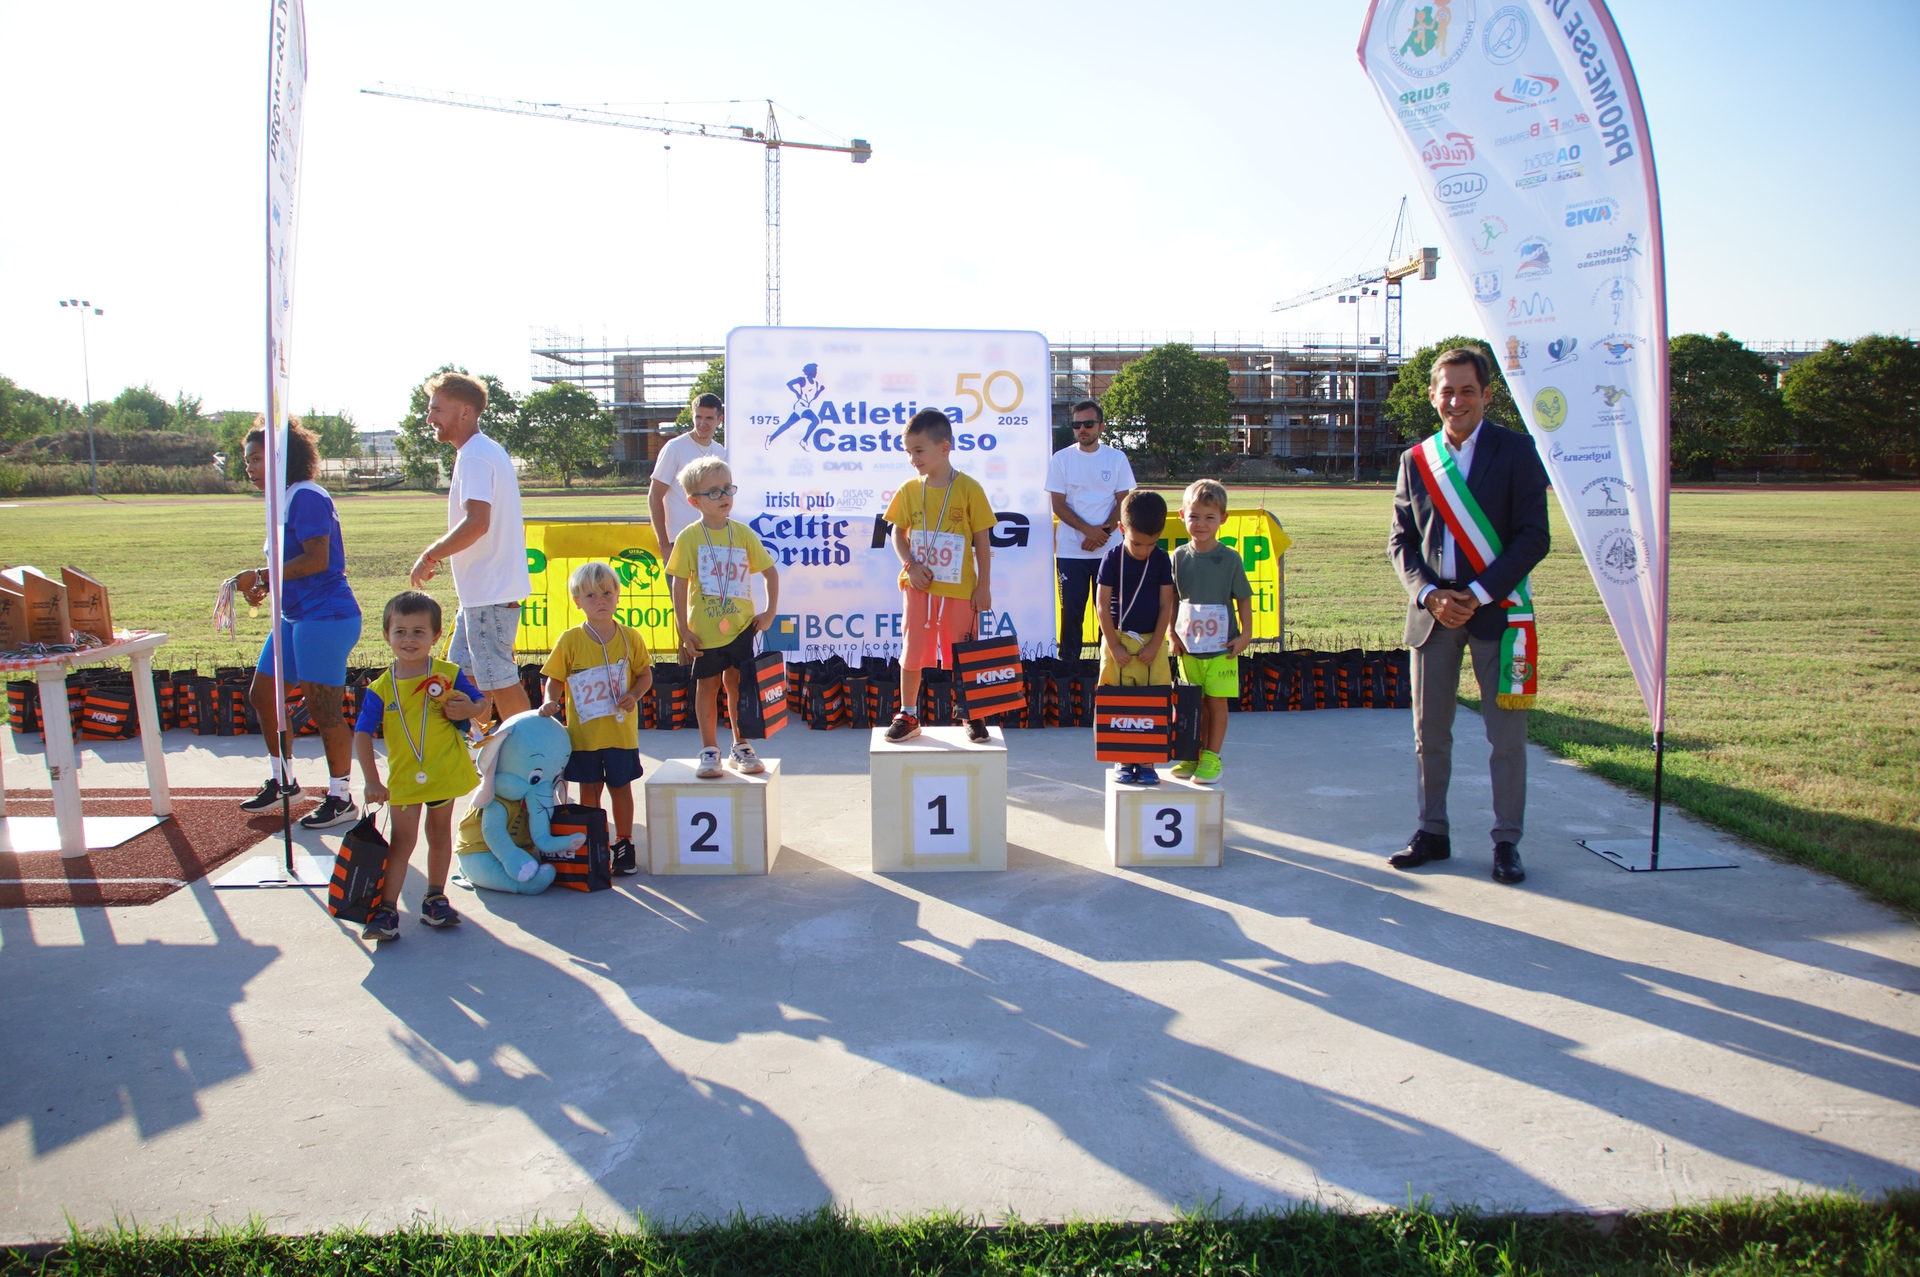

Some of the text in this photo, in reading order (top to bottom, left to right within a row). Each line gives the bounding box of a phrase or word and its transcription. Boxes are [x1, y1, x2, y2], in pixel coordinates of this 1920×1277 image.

[955, 370, 1024, 423] 50
[749, 415, 780, 425] 1975
[818, 400, 964, 425] Atletia
[997, 416, 1029, 425] 2025
[813, 427, 998, 452] Casteso
[766, 491, 835, 511] irish pub
[749, 512, 849, 540] Celtic
[871, 511, 1030, 549] KG
[917, 545, 953, 567] 539
[710, 561, 749, 583] 497
[614, 606, 675, 628] spor
[806, 611, 1018, 639] BCC FEEA
[806, 643, 903, 651] CREDITO COOP
[976, 667, 1016, 685] KING
[1218, 669, 1237, 679] WIN
[581, 679, 621, 705] 228
[764, 685, 783, 703] KING
[92, 711, 118, 723] KING
[1110, 717, 1154, 729] KING
[927, 795, 954, 835] 1
[690, 811, 719, 852] 2
[1153, 807, 1183, 849] 3
